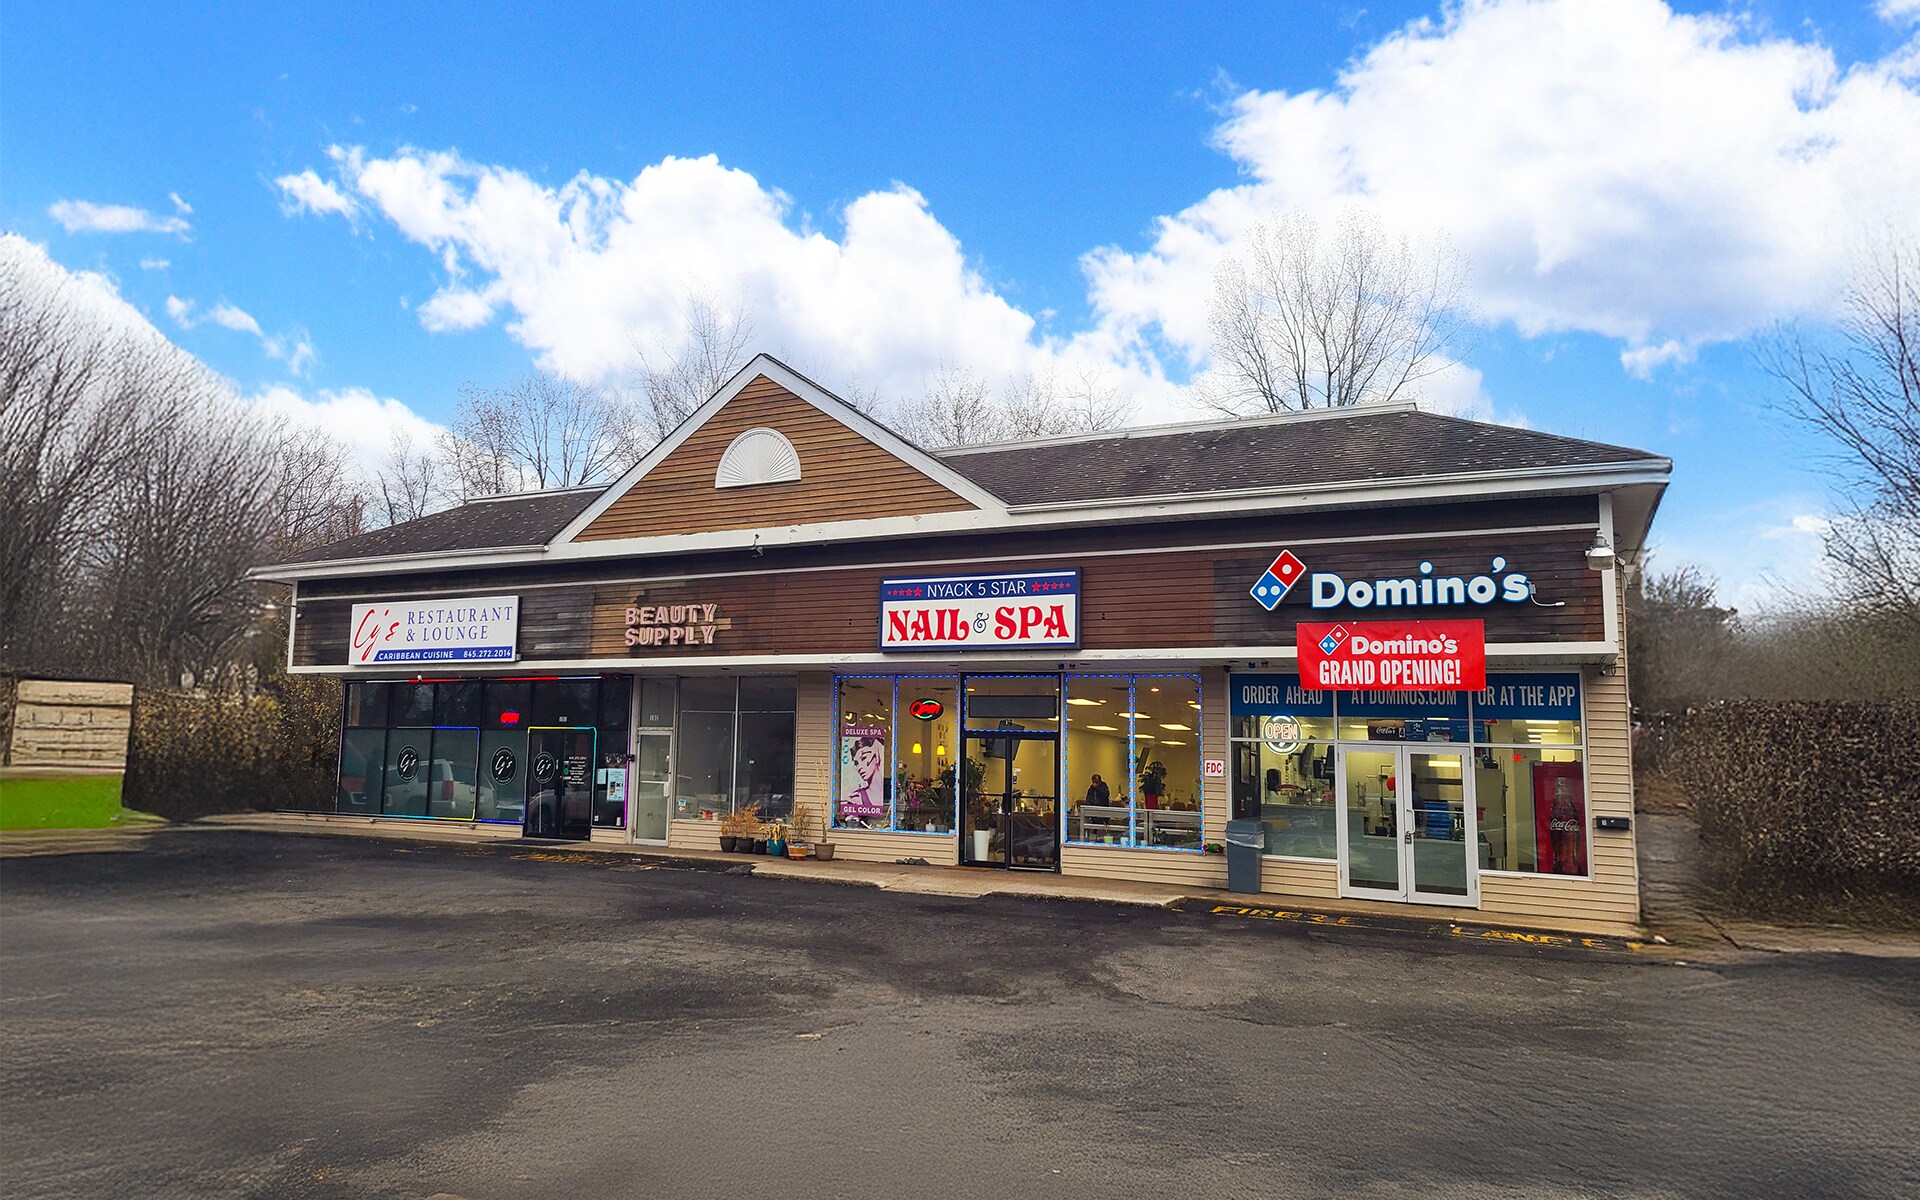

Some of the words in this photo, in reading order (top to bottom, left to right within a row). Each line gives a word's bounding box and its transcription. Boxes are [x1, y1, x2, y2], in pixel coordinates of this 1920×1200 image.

[927, 583, 974, 598] NYACK
[977, 583, 986, 595] 5
[990, 581, 1027, 595] STAR
[1311, 556, 1531, 609] Domino's
[407, 606, 513, 625] RESTAURANT
[625, 603, 718, 625] BEAUTY
[887, 608, 970, 642] NAIL
[972, 612, 990, 634] &
[993, 604, 1070, 640] SPA
[353, 609, 400, 662] Cy's
[406, 628, 415, 642] &
[423, 625, 489, 642] LOUNGE
[624, 625, 717, 647] SUPPLY
[1351, 633, 1458, 655] Domino's
[378, 651, 421, 661] CARIBBEAN
[422, 650, 454, 660] CUISINE
[463, 649, 512, 659] 845.272.2014
[1319, 659, 1375, 685] GRAND
[1380, 659, 1461, 685] OPENING!
[1242, 685, 1279, 704] ORDER
[1285, 685, 1323, 705] AHEAD
[1351, 690, 1364, 705] AT
[1369, 690, 1457, 705] DOMINOS.COM
[1477, 685, 1496, 706] OR
[1500, 685, 1516, 706] AT
[1519, 685, 1545, 706] THE
[1548, 685, 1576, 707] APP
[845, 728, 869, 736] DELUXE
[870, 728, 882, 736] SPA
[1265, 722, 1298, 739] OPEN
[1205, 762, 1222, 774] FDC
[857, 806, 881, 814] COLOR
